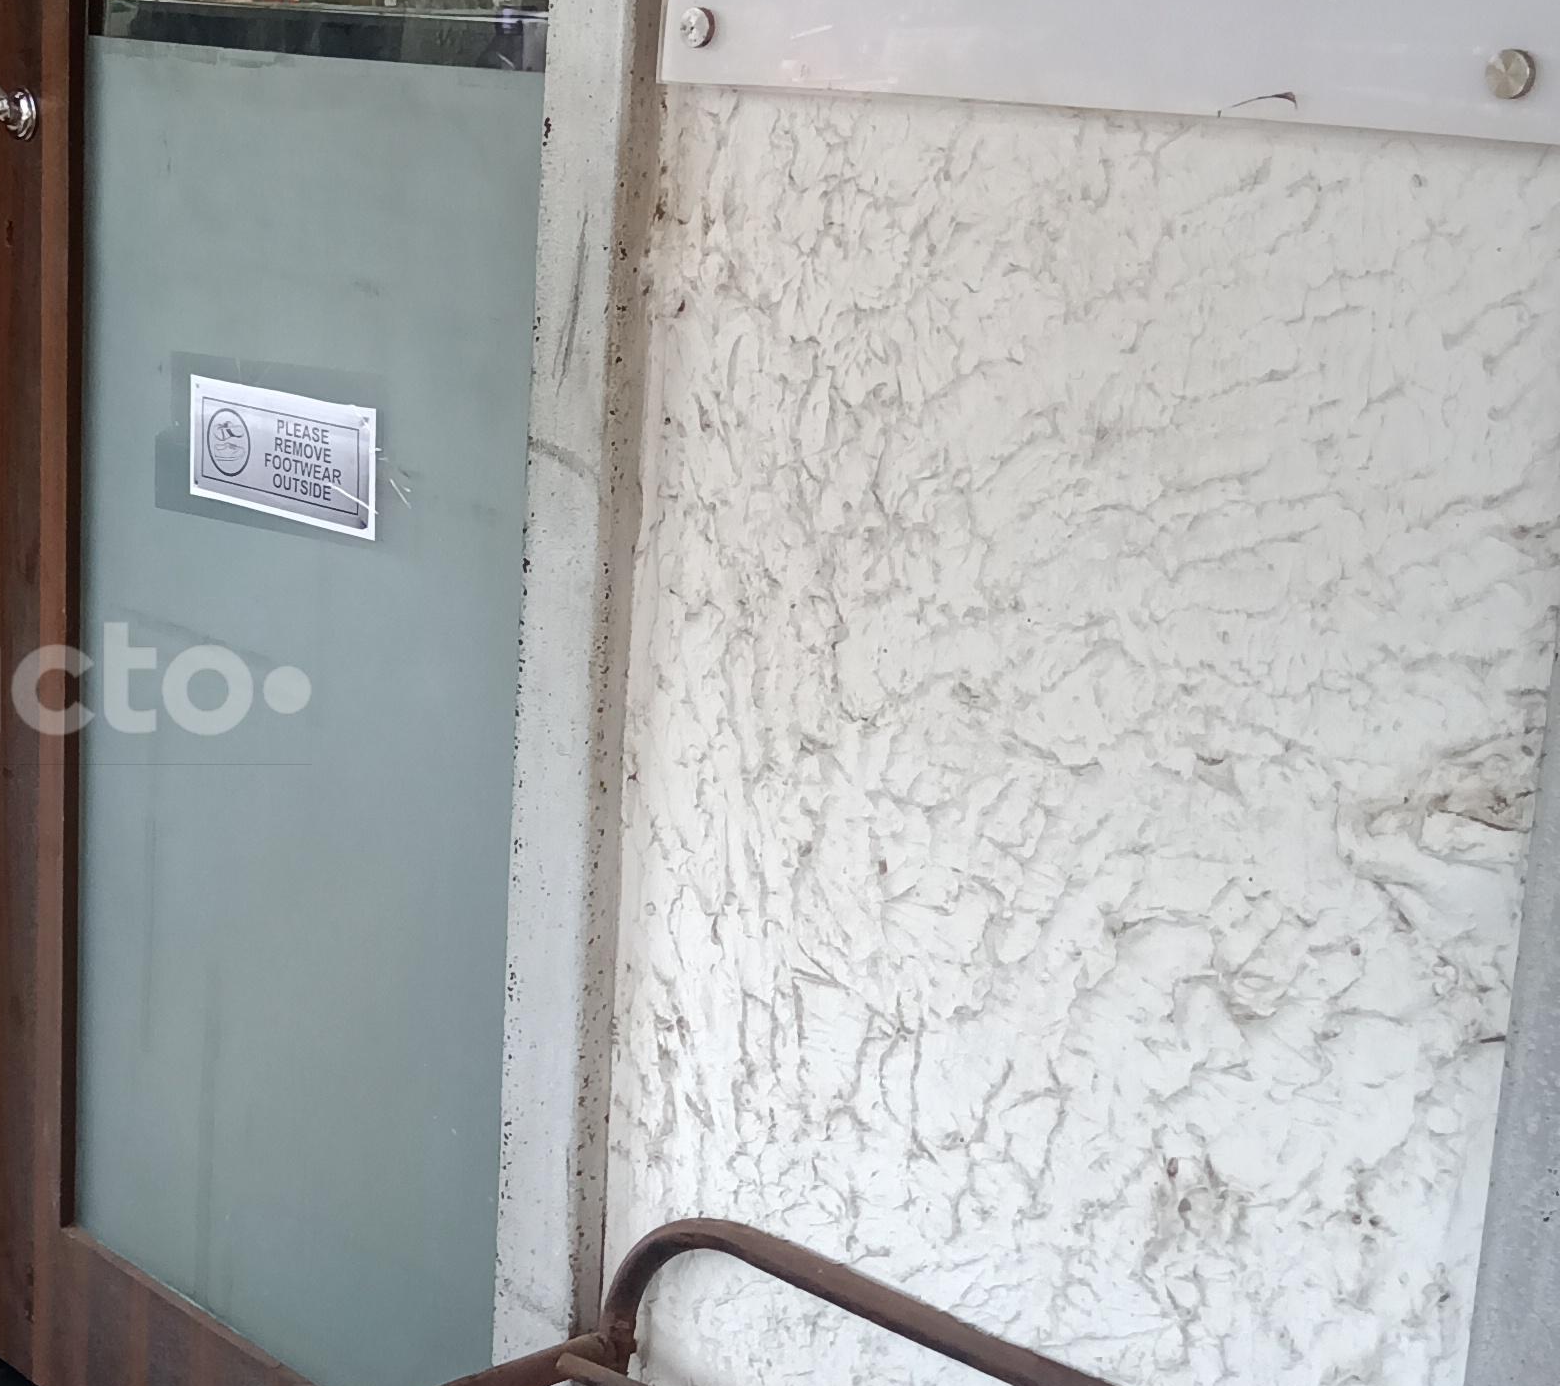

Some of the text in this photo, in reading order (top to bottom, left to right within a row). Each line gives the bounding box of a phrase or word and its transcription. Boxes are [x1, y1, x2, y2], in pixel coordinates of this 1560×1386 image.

[276, 419, 330, 445] PLEASE
[274, 437, 332, 463] REMOVE
[264, 453, 342, 485] FOOTWEAR
[272, 474, 332, 501] OUTSIDE
